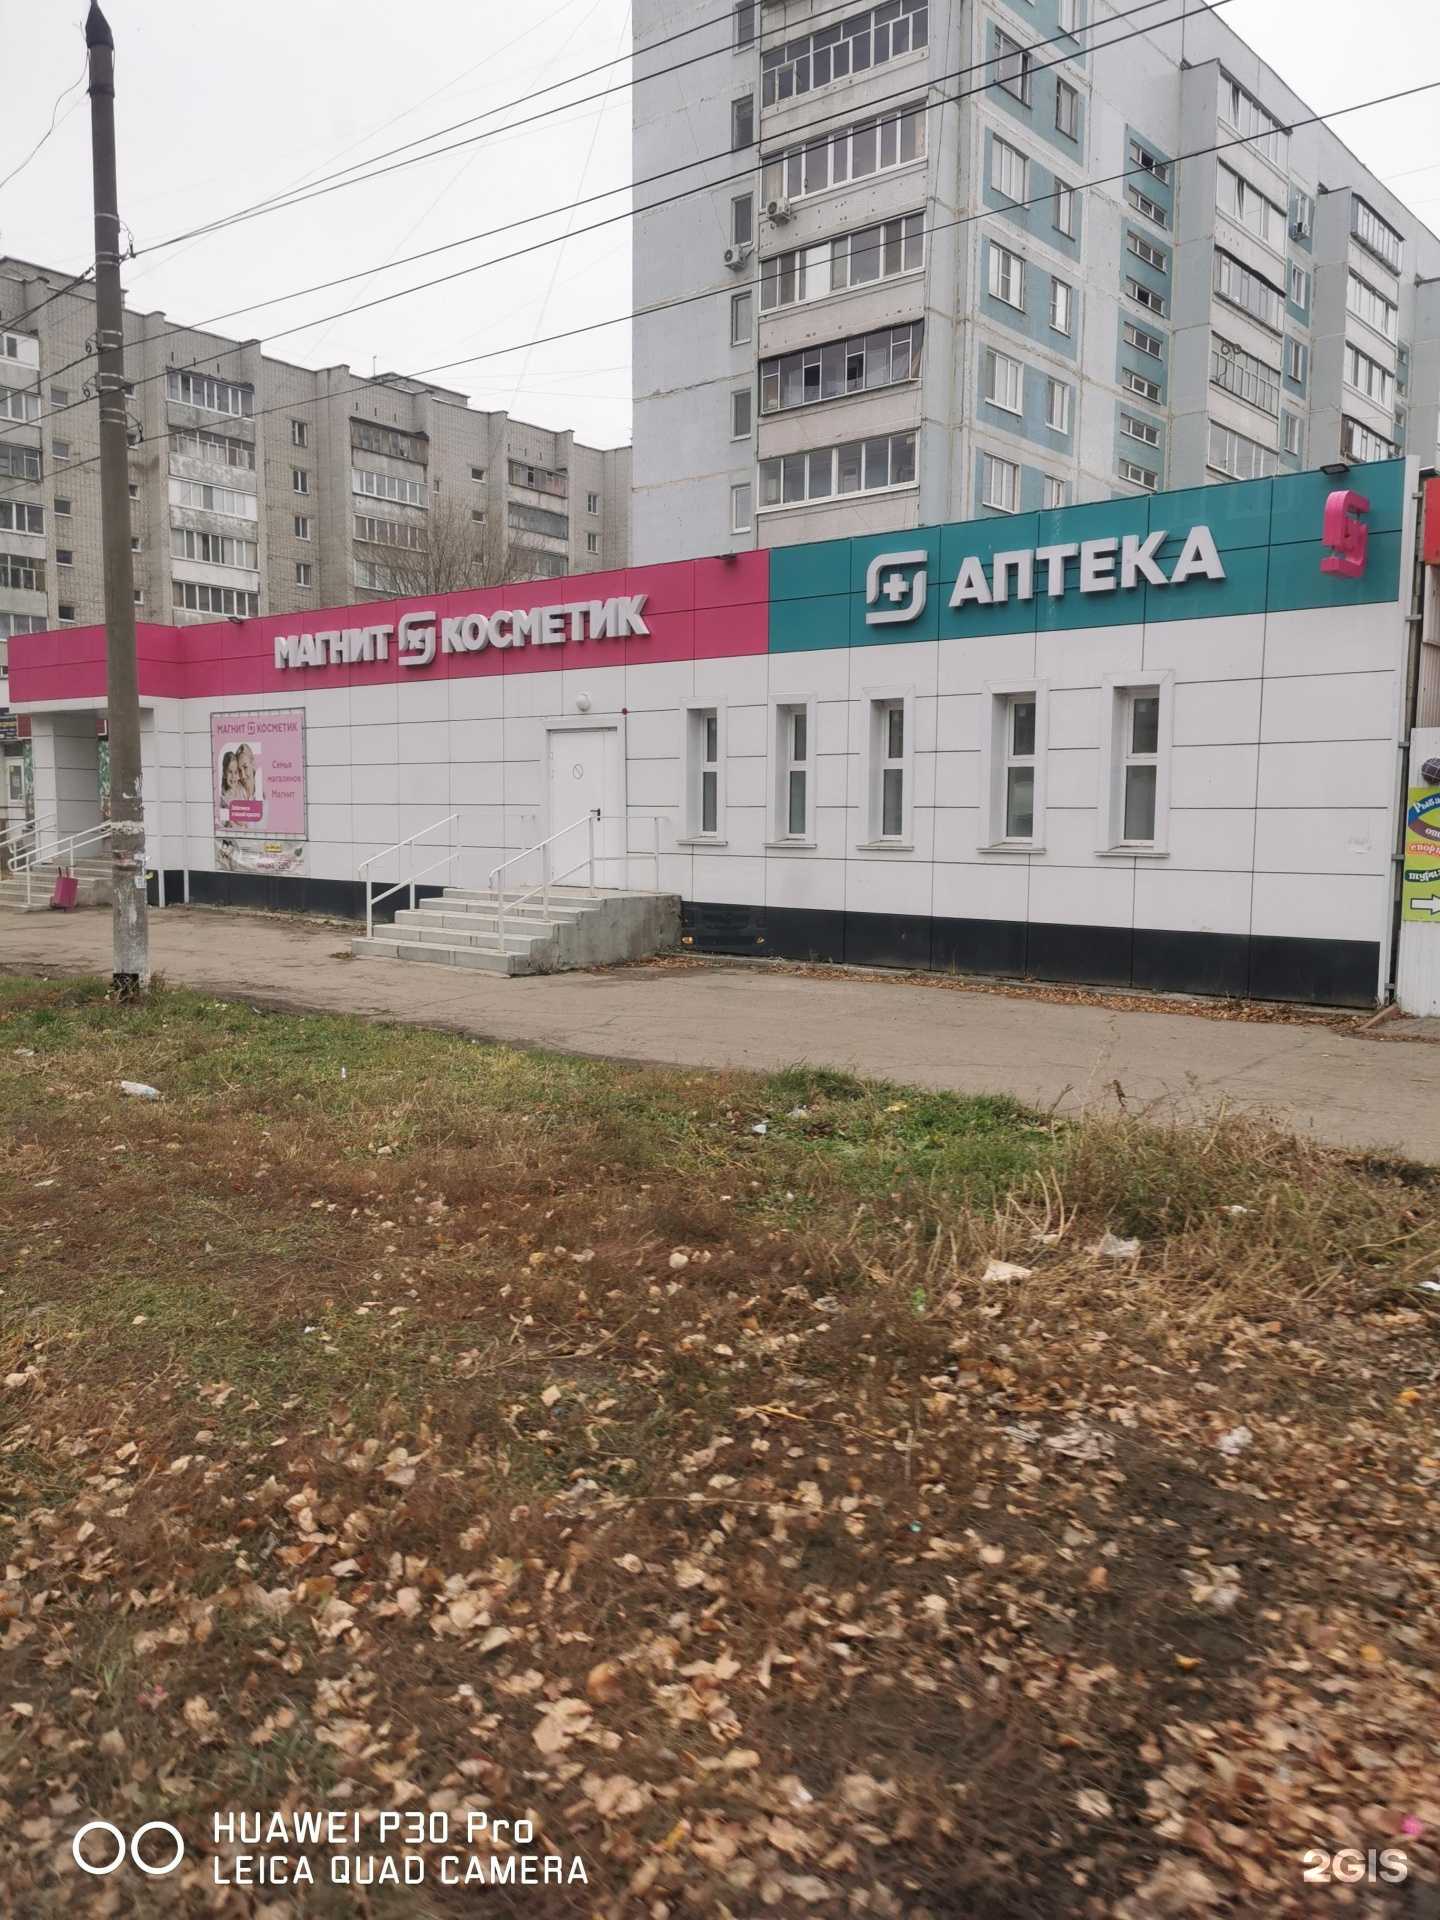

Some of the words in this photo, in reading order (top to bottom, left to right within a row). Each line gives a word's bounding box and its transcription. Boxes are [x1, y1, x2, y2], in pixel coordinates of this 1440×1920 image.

[948, 525, 1228, 608] АПТЕКА
[274, 625, 393, 669] МАГНИТ
[441, 594, 650, 654] КОСМЕТИК
[217, 723, 246, 734] МАГНИТ
[257, 721, 298, 733] КОСМЕТИК
[271, 760, 292, 769] Семья
[271, 789, 295, 800] Магнит
